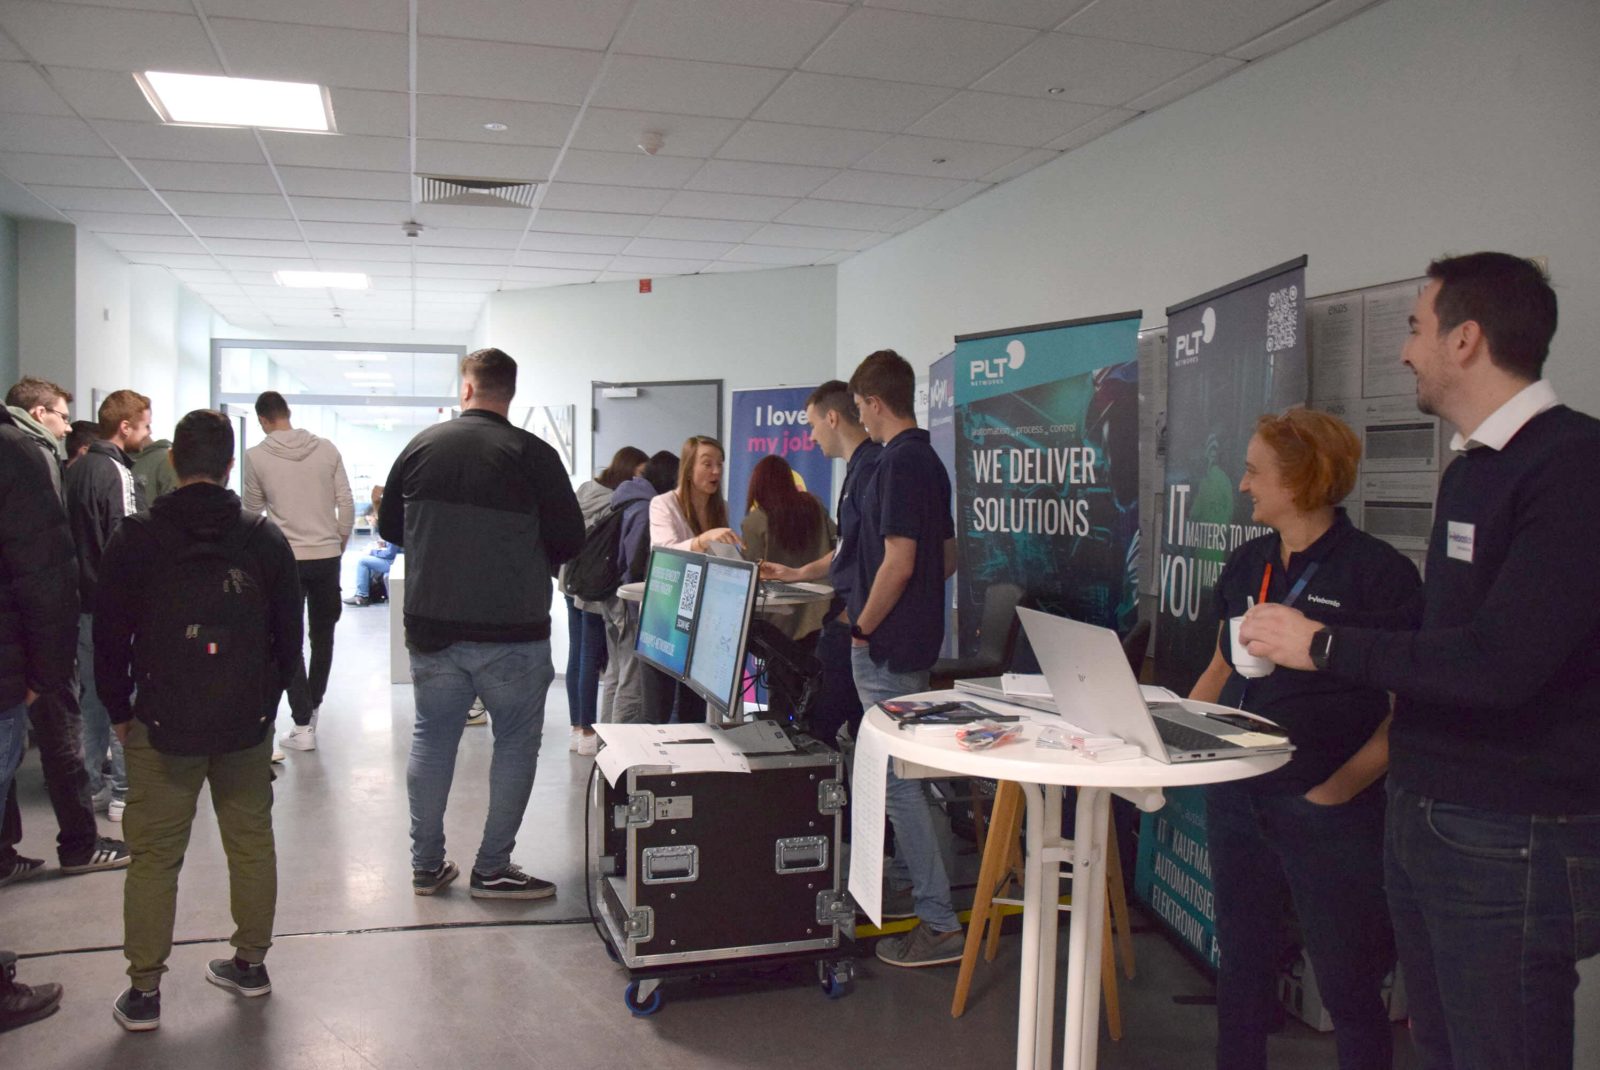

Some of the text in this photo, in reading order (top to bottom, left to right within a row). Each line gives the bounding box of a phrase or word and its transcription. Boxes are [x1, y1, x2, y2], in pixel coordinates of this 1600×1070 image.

[1176, 329, 1203, 360] PLT
[970, 358, 1008, 380] PLT
[756, 405, 808, 426] I love
[748, 430, 815, 457] my job
[972, 446, 1096, 485] WE DELIVER
[973, 497, 1090, 537] SOLUTIONS
[1168, 484, 1190, 546] IT
[1185, 521, 1227, 551] MATTERS
[1160, 553, 1201, 622] YOU
[1157, 817, 1167, 844] IT
[1152, 884, 1204, 953] ELEKTRONIK
